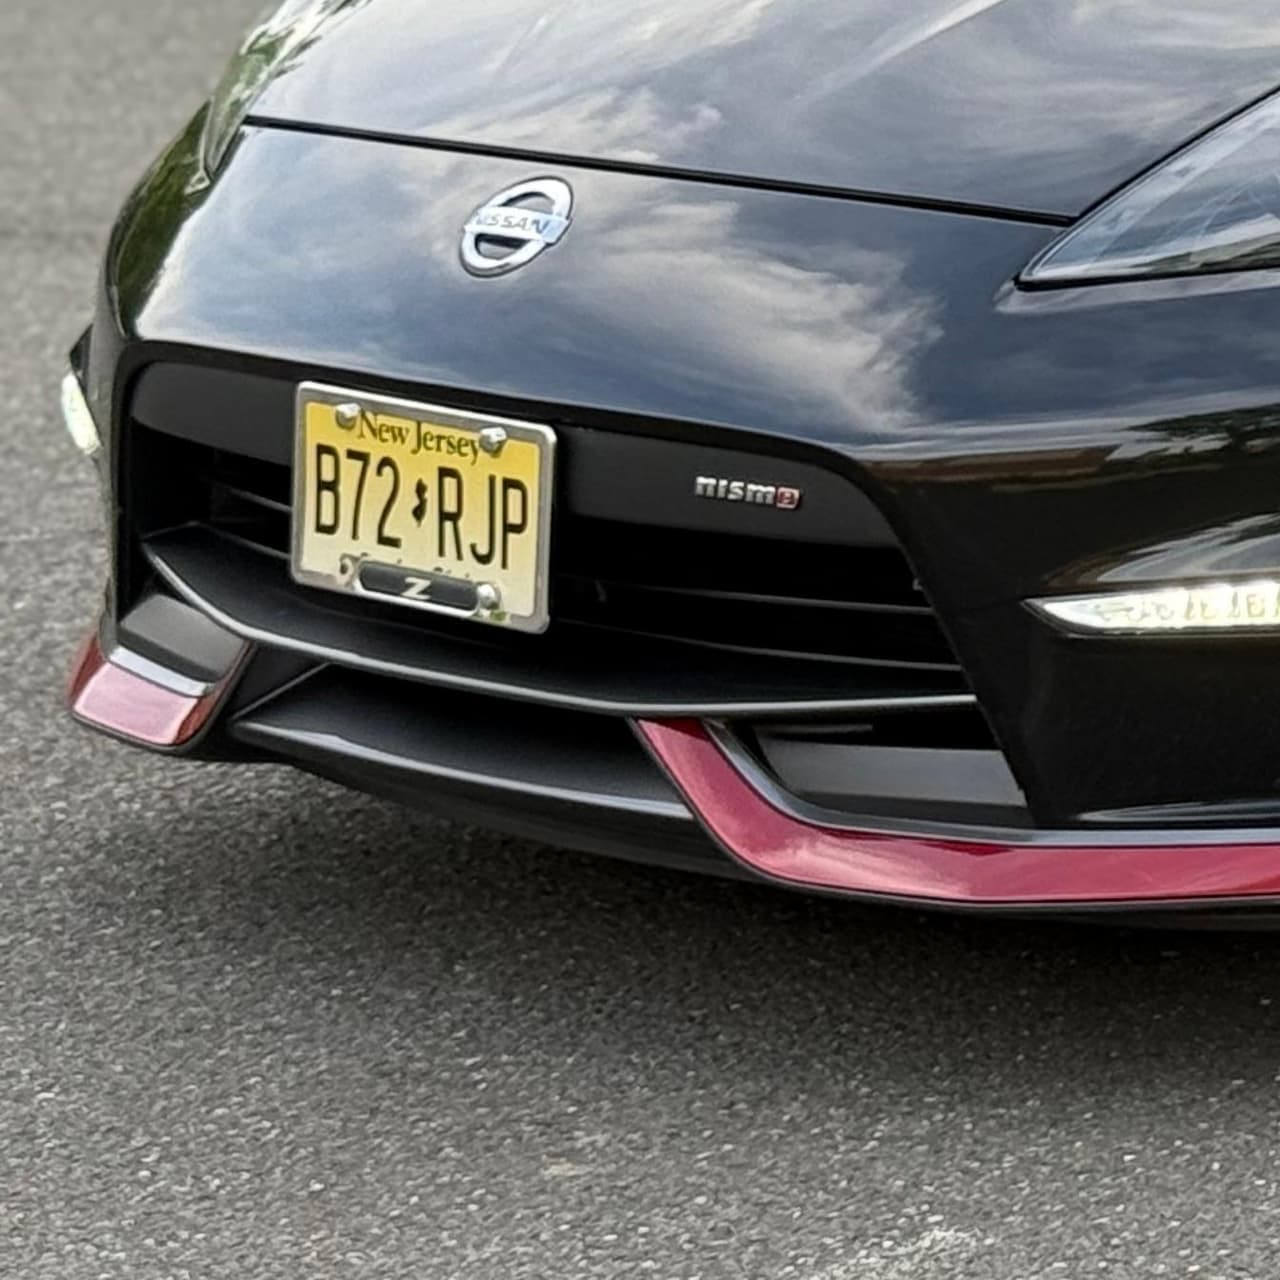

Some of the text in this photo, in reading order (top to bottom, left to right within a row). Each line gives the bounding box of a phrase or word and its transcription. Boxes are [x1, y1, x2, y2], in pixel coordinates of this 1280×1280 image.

[357, 408, 480, 465] New Jersey
[401, 576, 432, 600] Z
